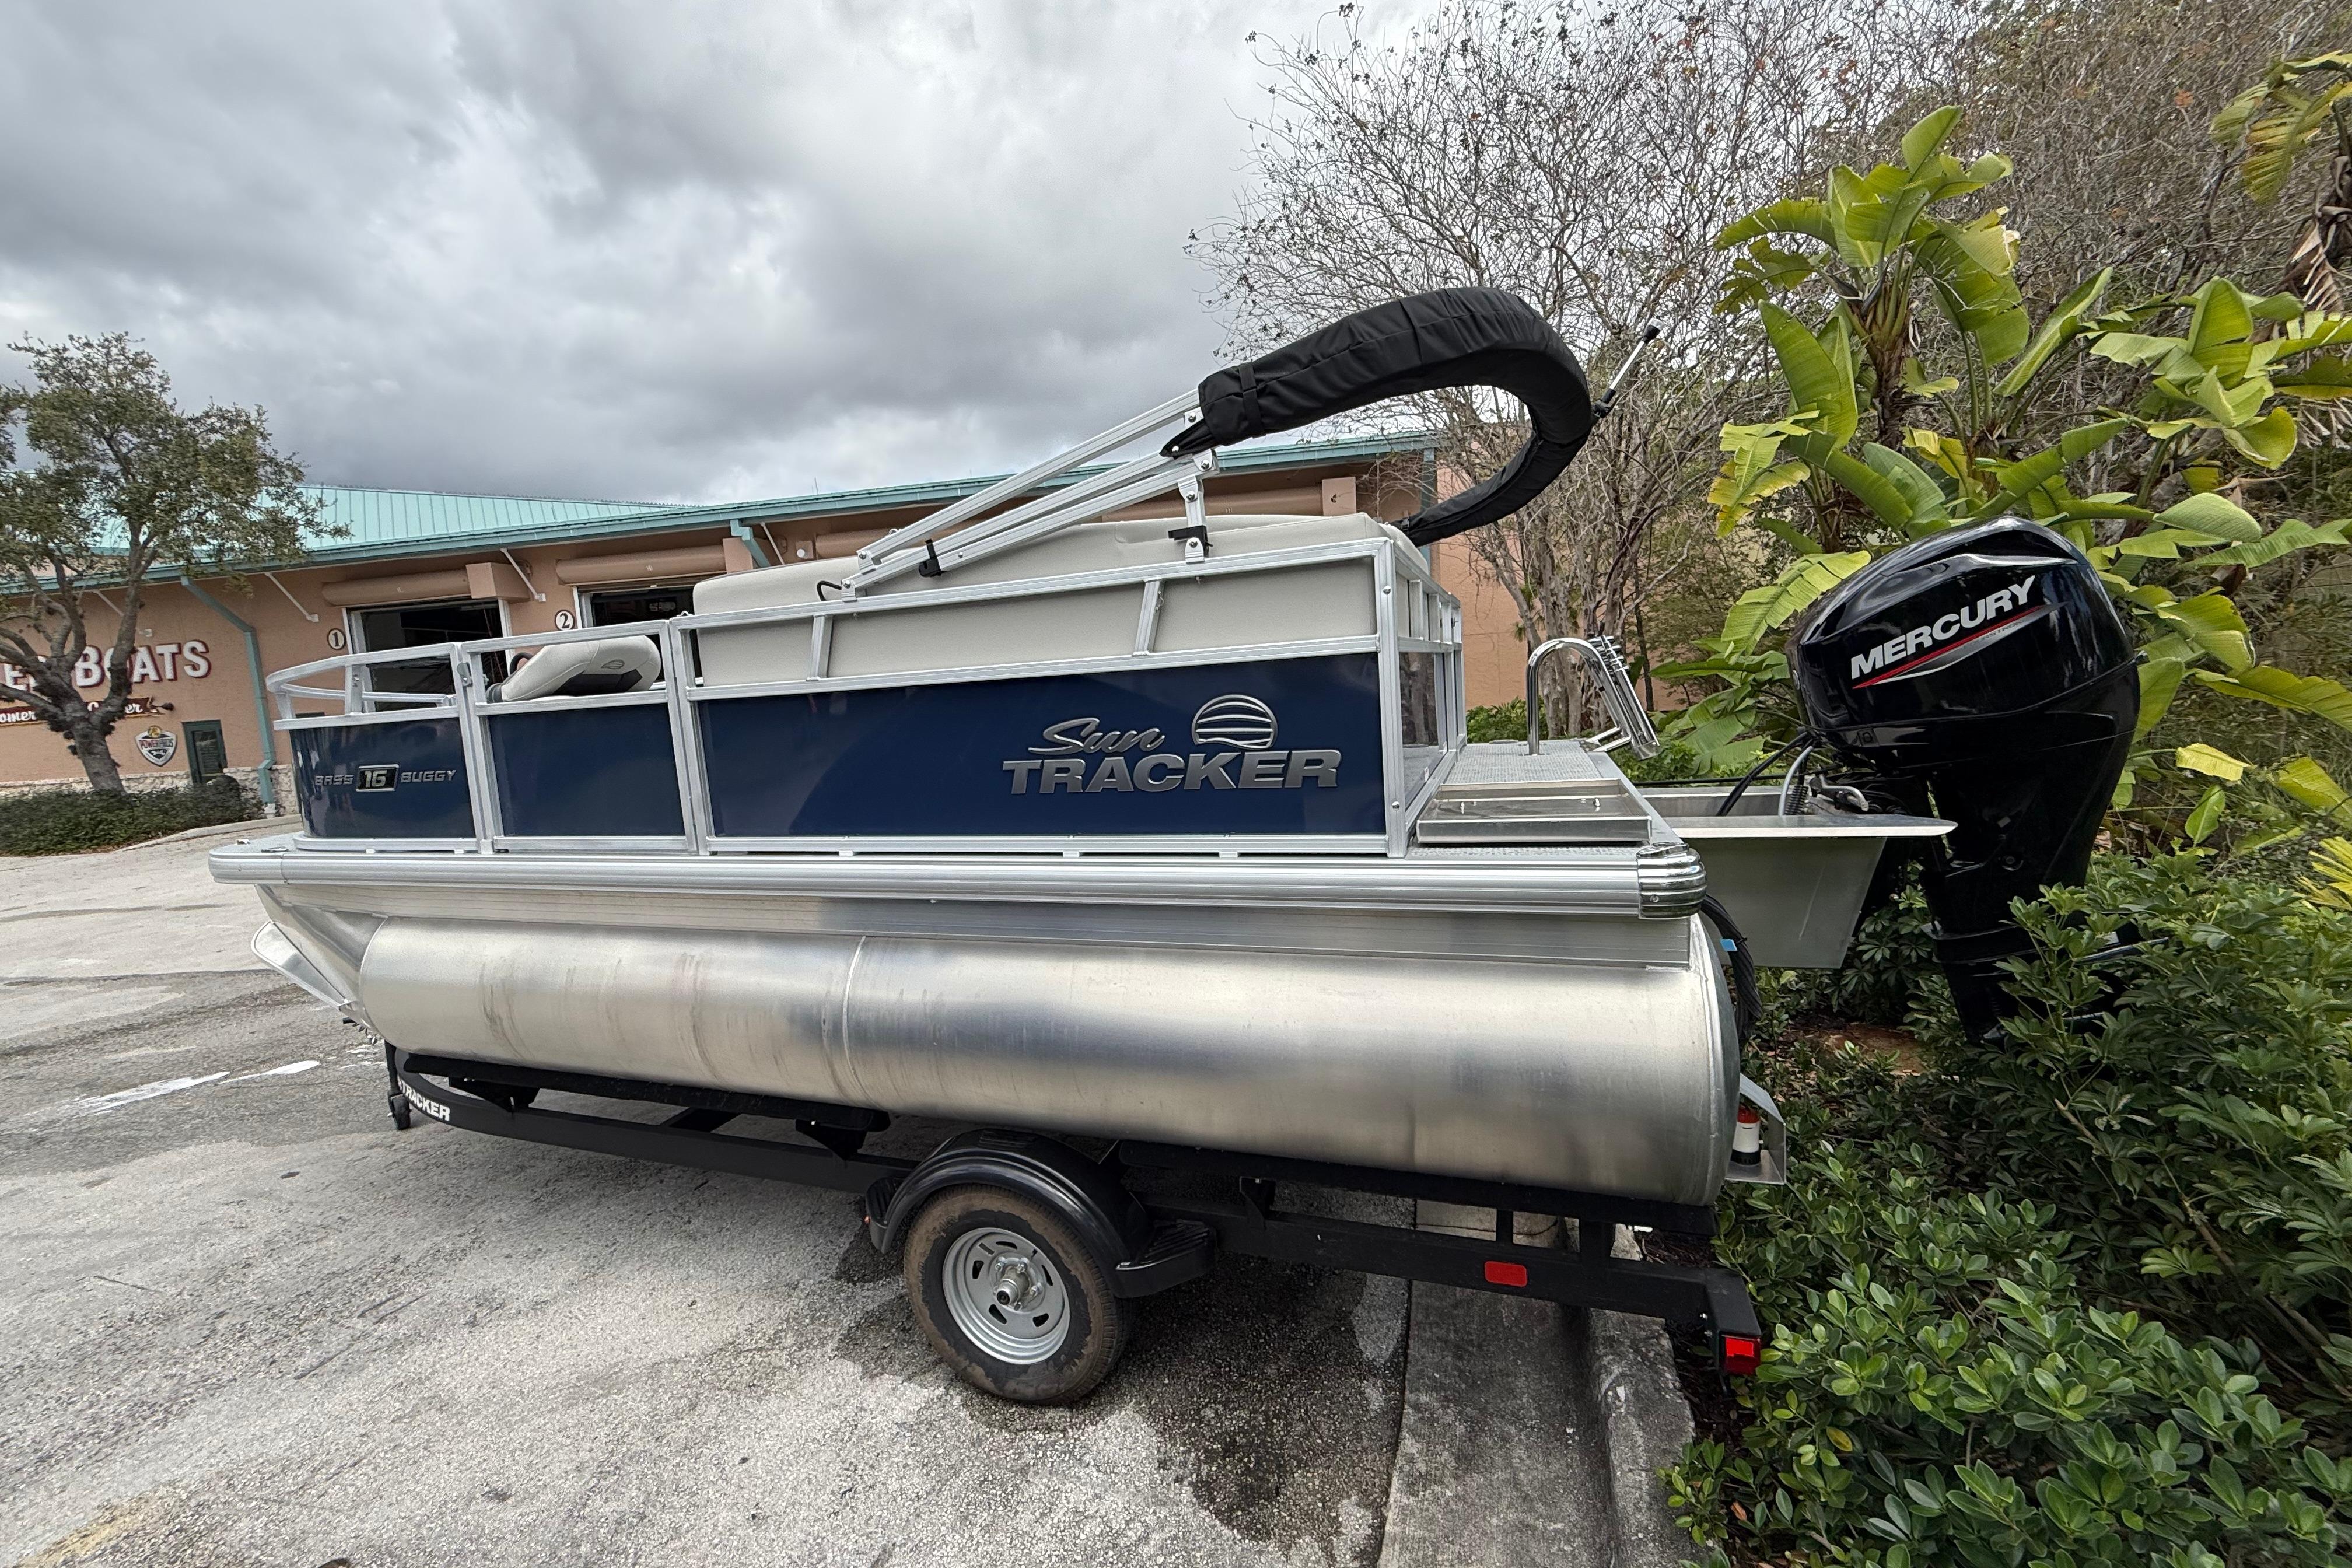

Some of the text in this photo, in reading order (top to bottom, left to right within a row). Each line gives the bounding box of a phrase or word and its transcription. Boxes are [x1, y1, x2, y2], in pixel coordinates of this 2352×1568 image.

[332, 631, 341, 647] 1
[560, 612, 570, 628] 2
[1851, 575, 2035, 680] MERCURY
[1028, 717, 1166, 755] Sun
[315, 769, 457, 788] BASS 16 BUGGY
[1002, 750, 1341, 794] TRACKER
[401, 1079, 450, 1121] TRACKER
